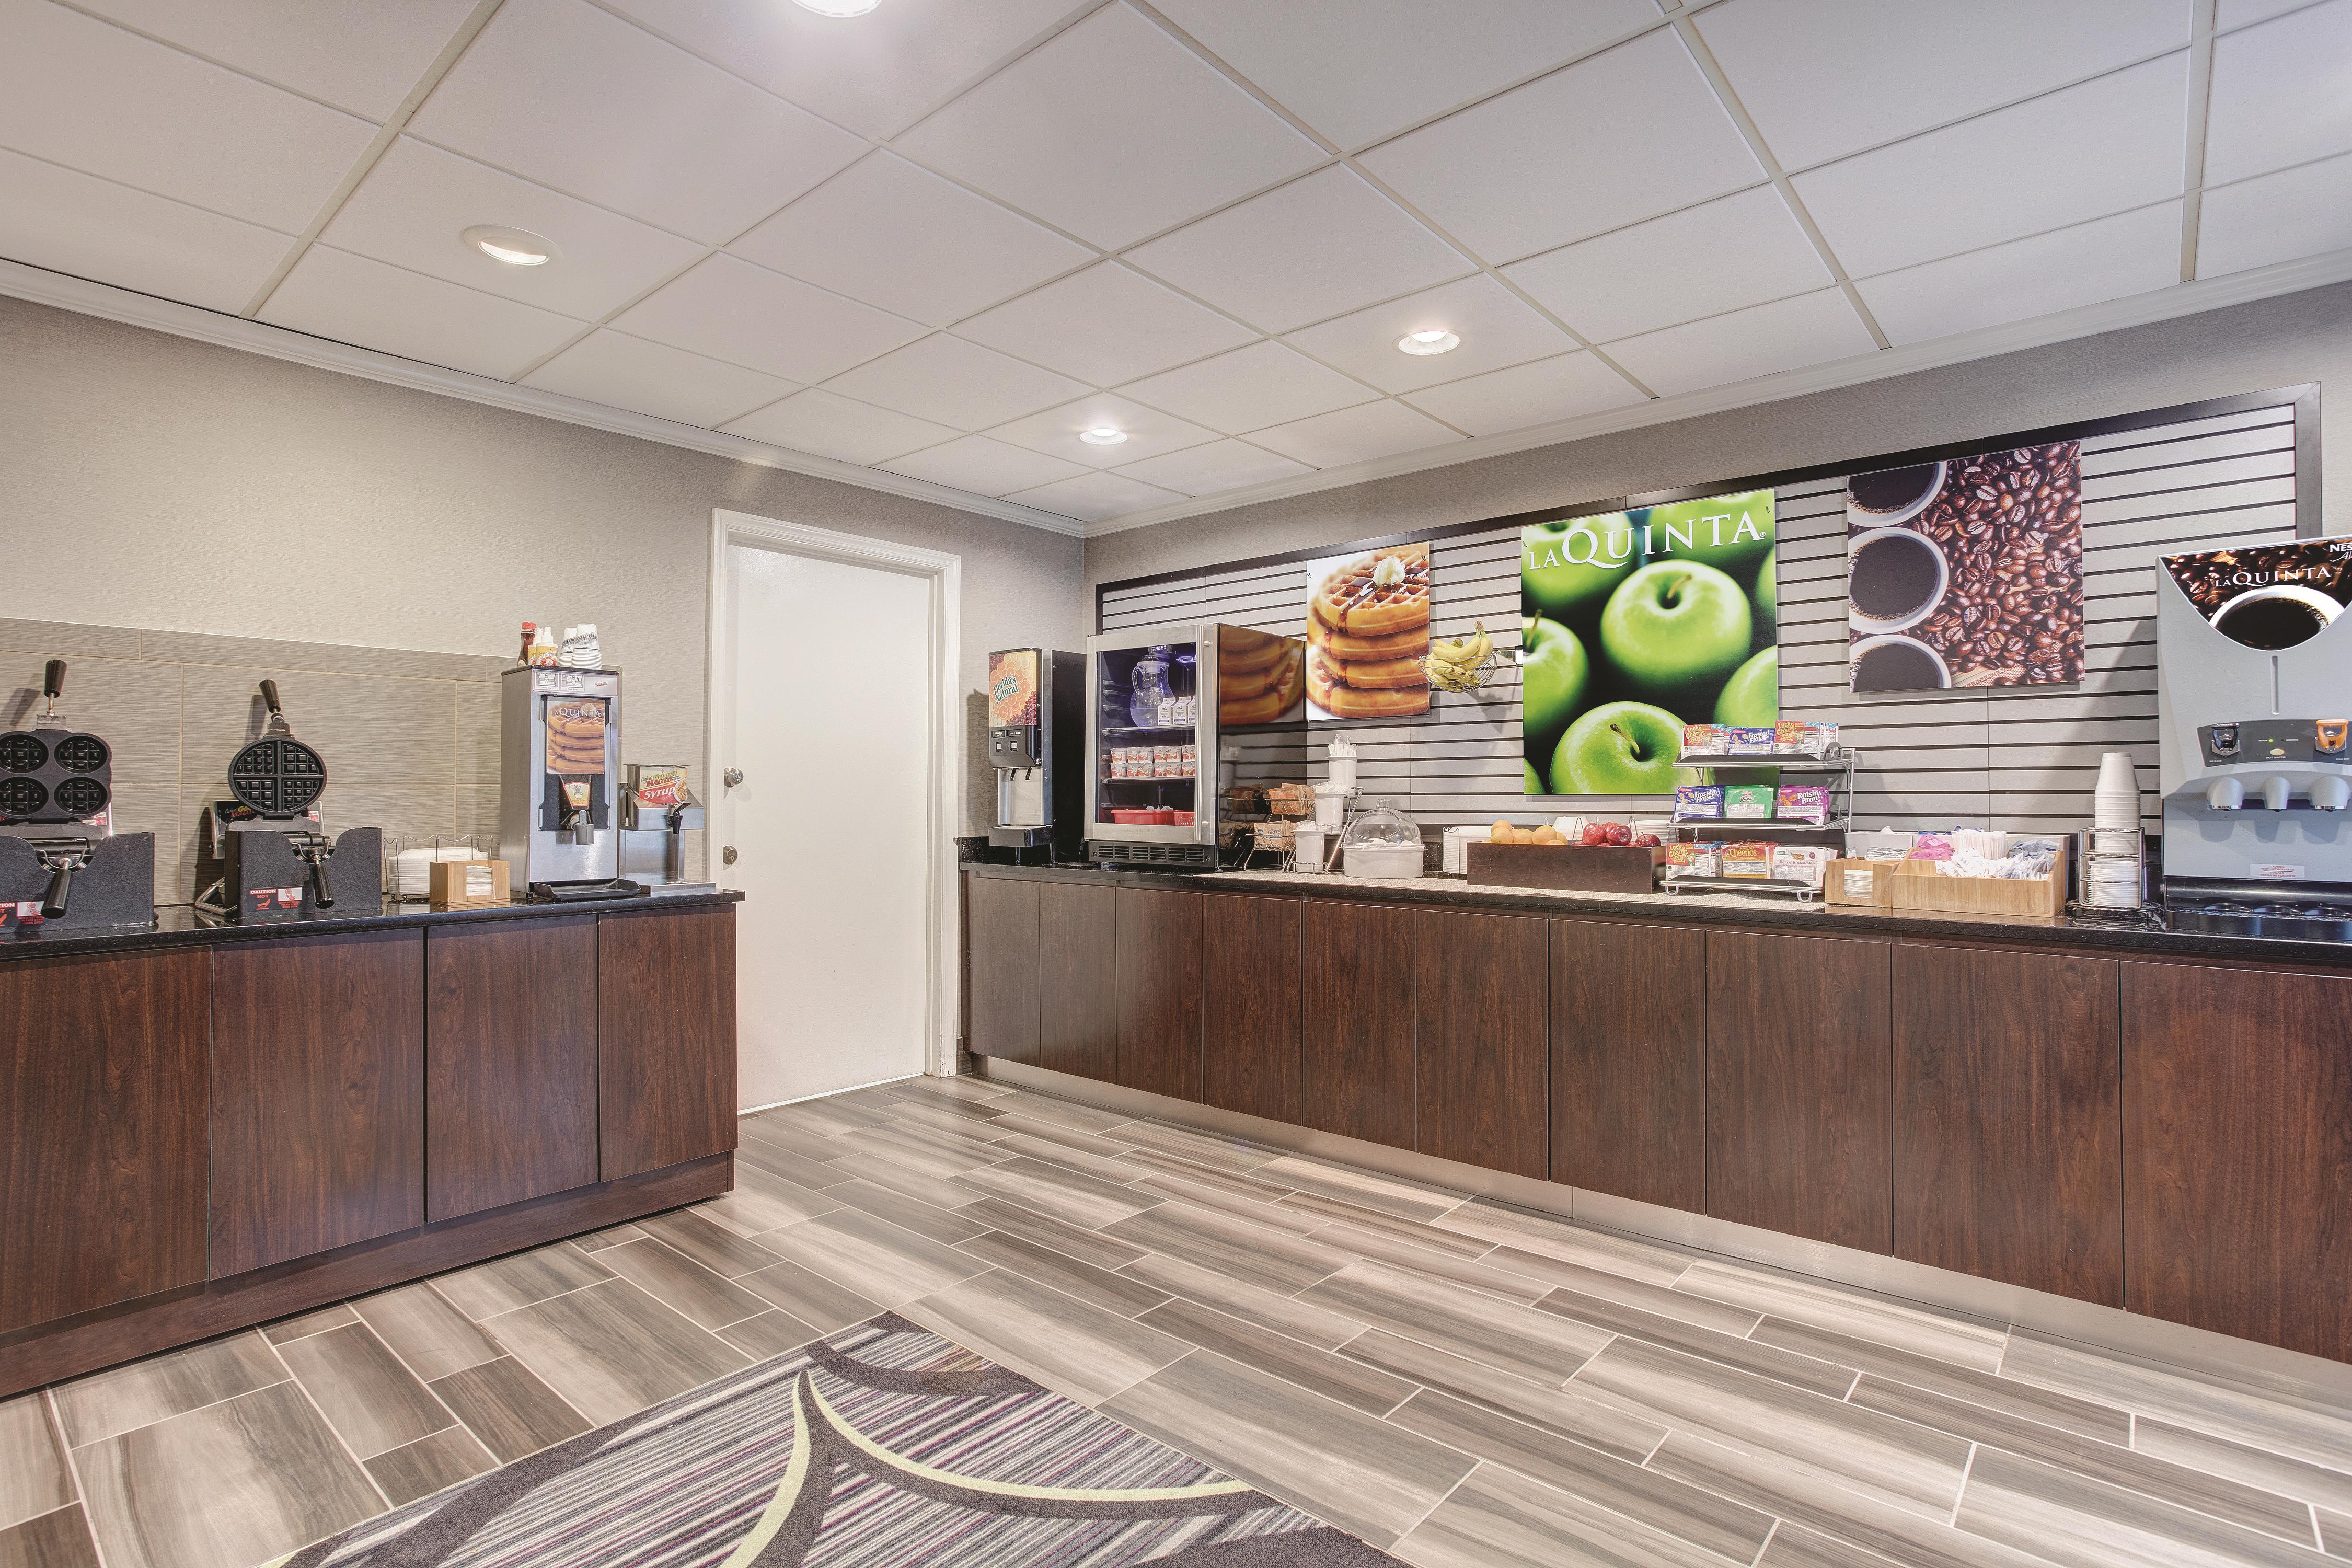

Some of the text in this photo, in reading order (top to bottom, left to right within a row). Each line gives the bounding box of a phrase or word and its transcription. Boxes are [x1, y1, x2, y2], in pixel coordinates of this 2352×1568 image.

[1529, 549, 1560, 570] LA
[2232, 567, 2332, 587] QUINTA
[994, 676, 1017, 695] Florida's
[996, 684, 1019, 702] Natural
[559, 707, 601, 718] QUINTA
[1686, 731, 1705, 739] Charms
[1777, 728, 1798, 736] Charms
[653, 770, 678, 780] GOLDEN
[646, 777, 672, 787] MALTED
[643, 786, 675, 799] Syrup
[1801, 795, 1818, 804] Bran
[1668, 849, 1688, 858] Charms
